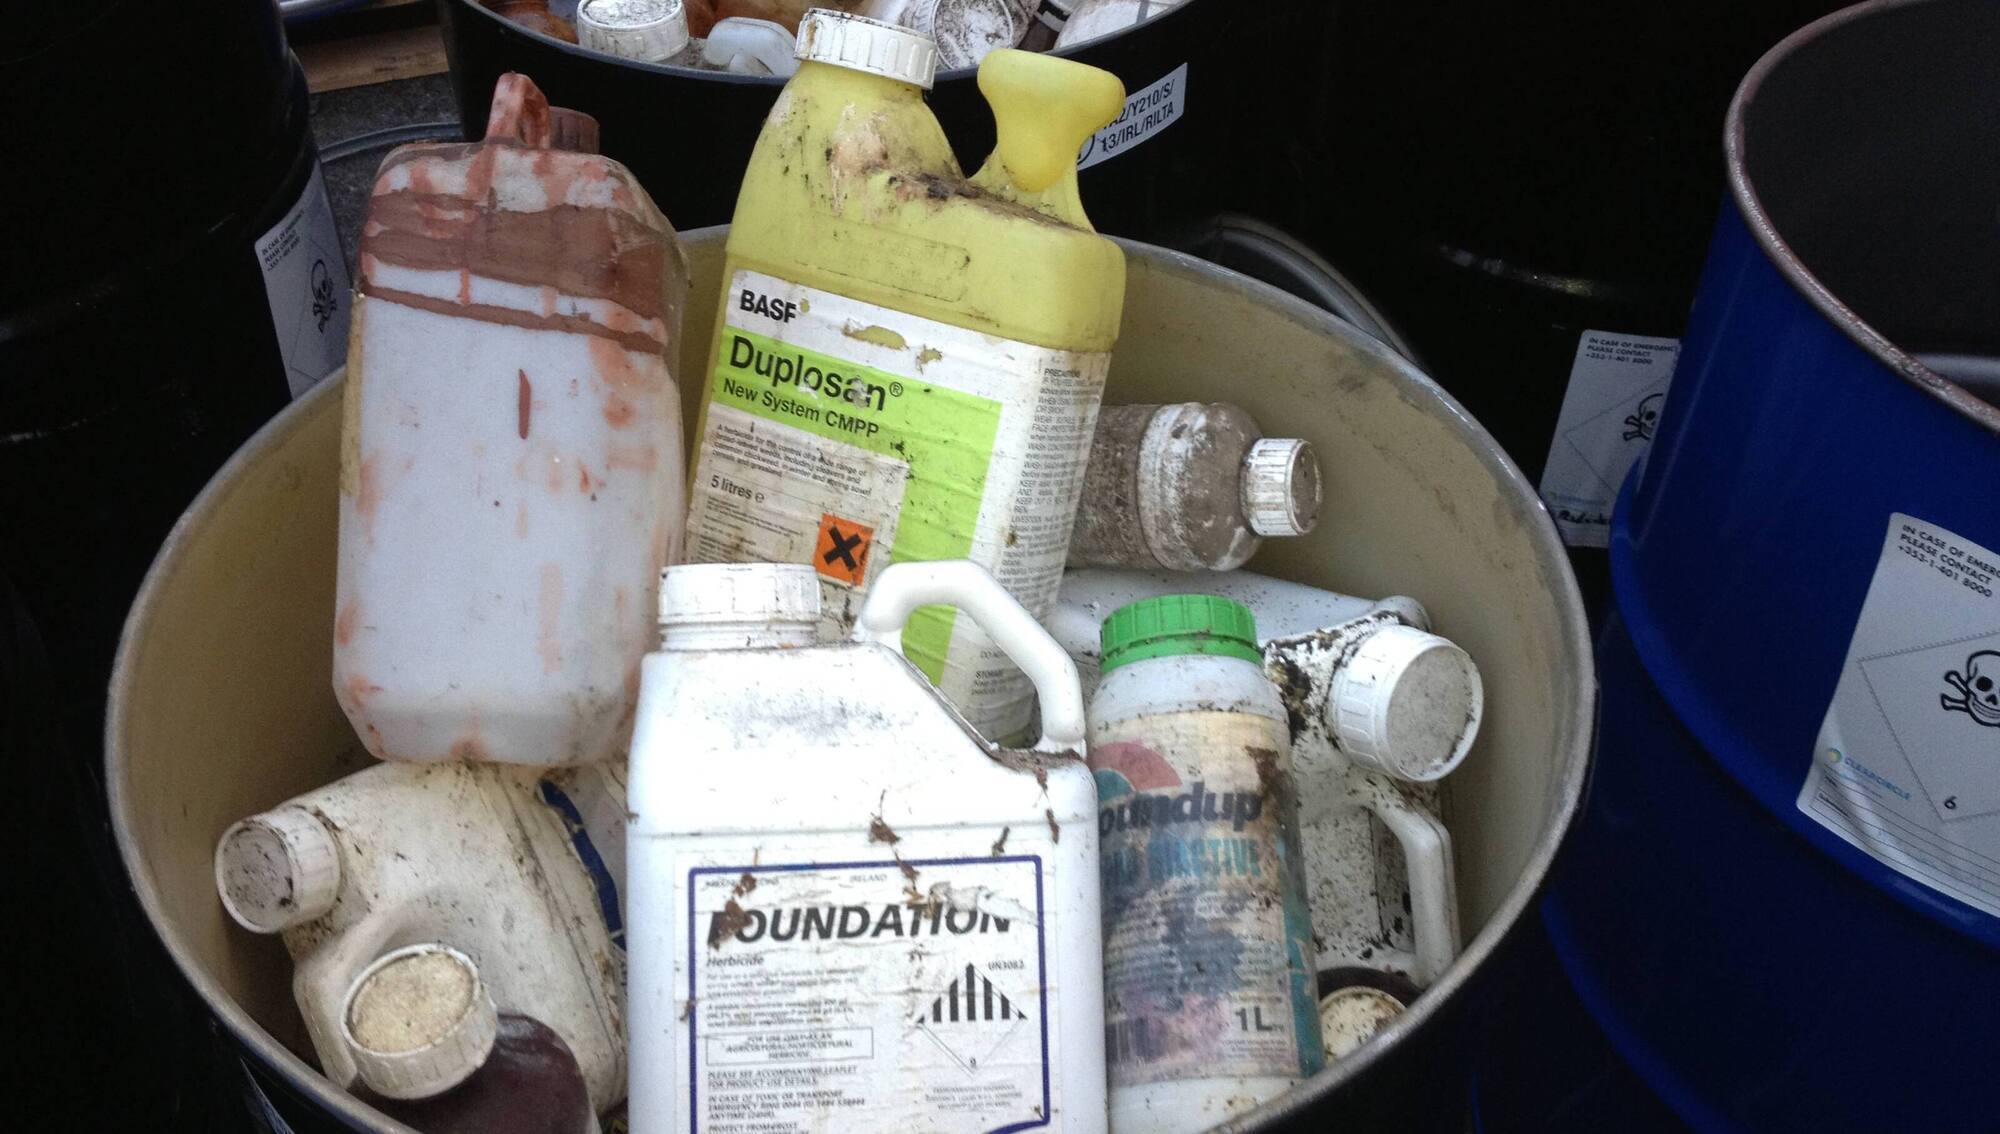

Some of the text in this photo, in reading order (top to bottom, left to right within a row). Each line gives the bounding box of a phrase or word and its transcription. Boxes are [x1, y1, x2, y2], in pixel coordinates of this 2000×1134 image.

[1103, 79, 1175, 130] 2/Y210/S/
[740, 289, 797, 323] BASF
[724, 378, 879, 437] New System CMPP
[711, 474, 719, 488] 5
[721, 478, 752, 499] litres
[1902, 524, 1916, 535] IN
[1919, 531, 1946, 549] CASE
[1949, 546, 1965, 558] OF
[1900, 533, 1992, 584] PLEASE CONTACT
[1963, 578, 1993, 597] 8000
[1099, 782, 1263, 837] oundup
[1944, 795, 1958, 810] 6
[706, 953, 764, 967] Herbicide
